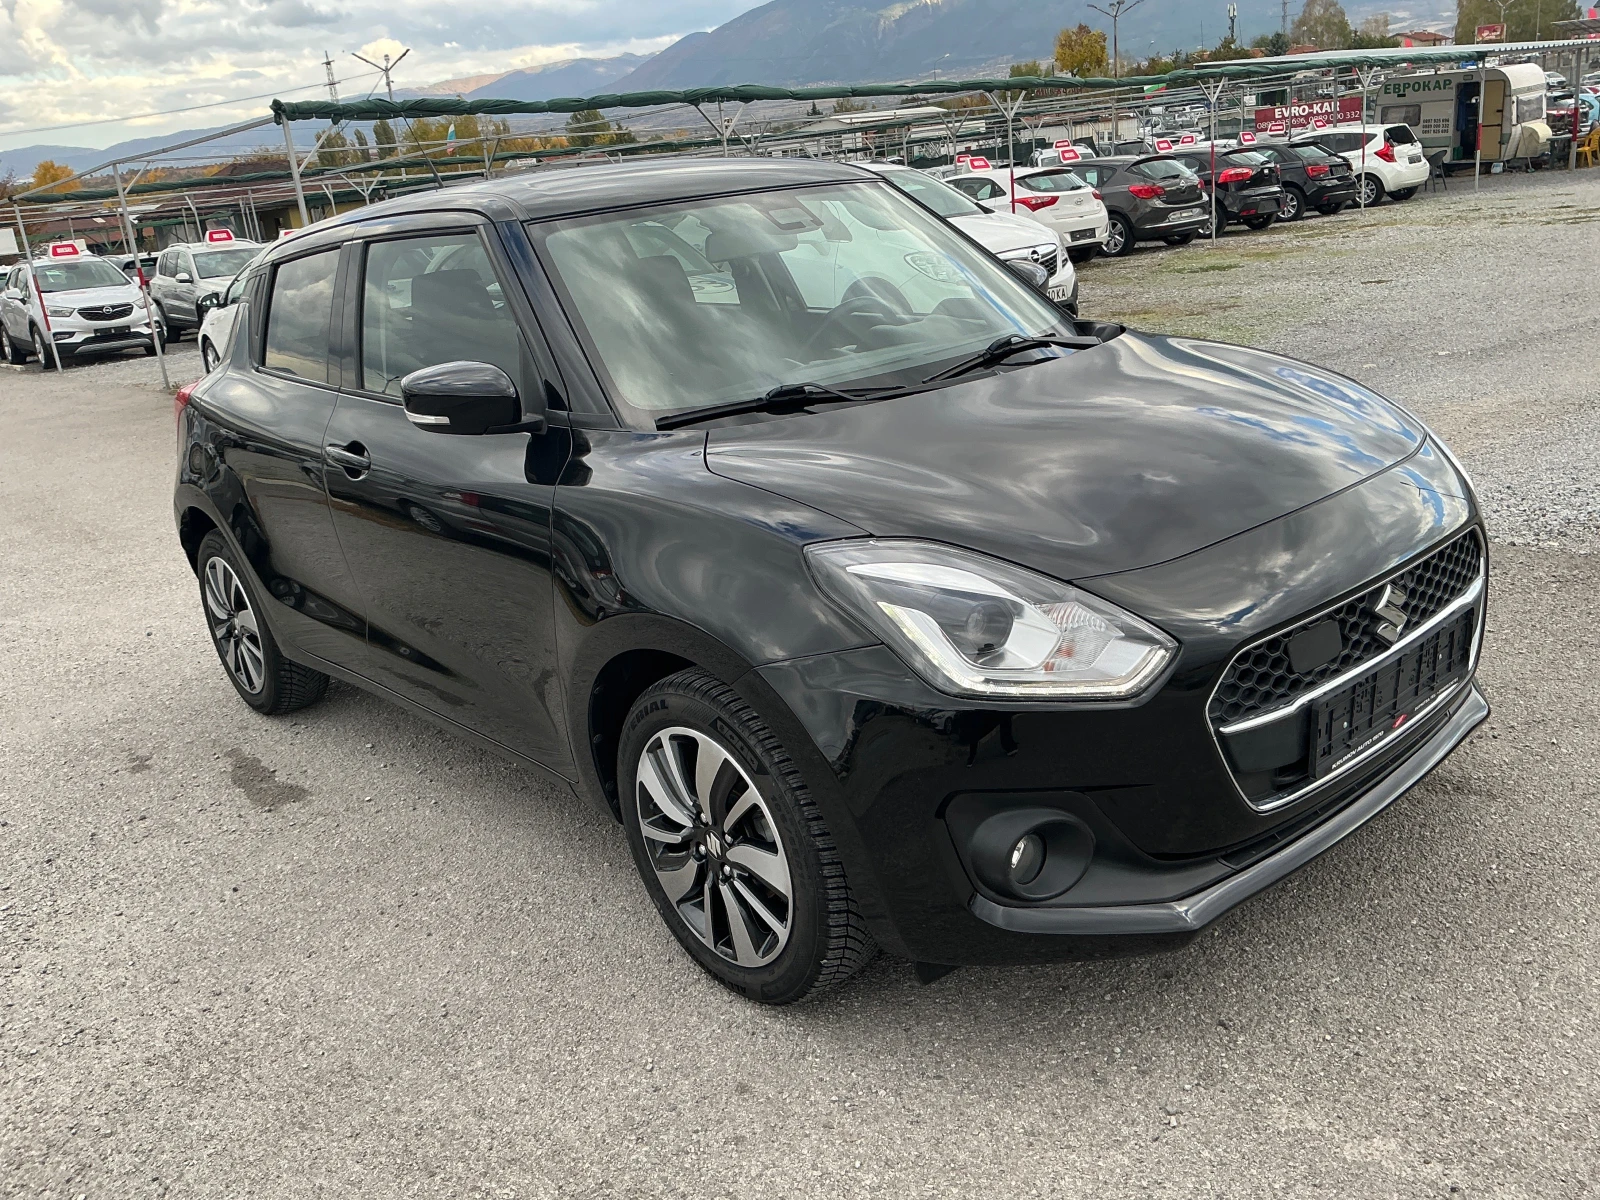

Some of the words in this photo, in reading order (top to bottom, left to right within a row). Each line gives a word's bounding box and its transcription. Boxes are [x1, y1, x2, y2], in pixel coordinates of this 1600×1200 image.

[1383, 79, 1453, 94] ЕВРОКАР
[1329, 112, 1344, 120] 00
[1345, 110, 1360, 119] 332
[1356, 738, 1372, 752] AUTO
